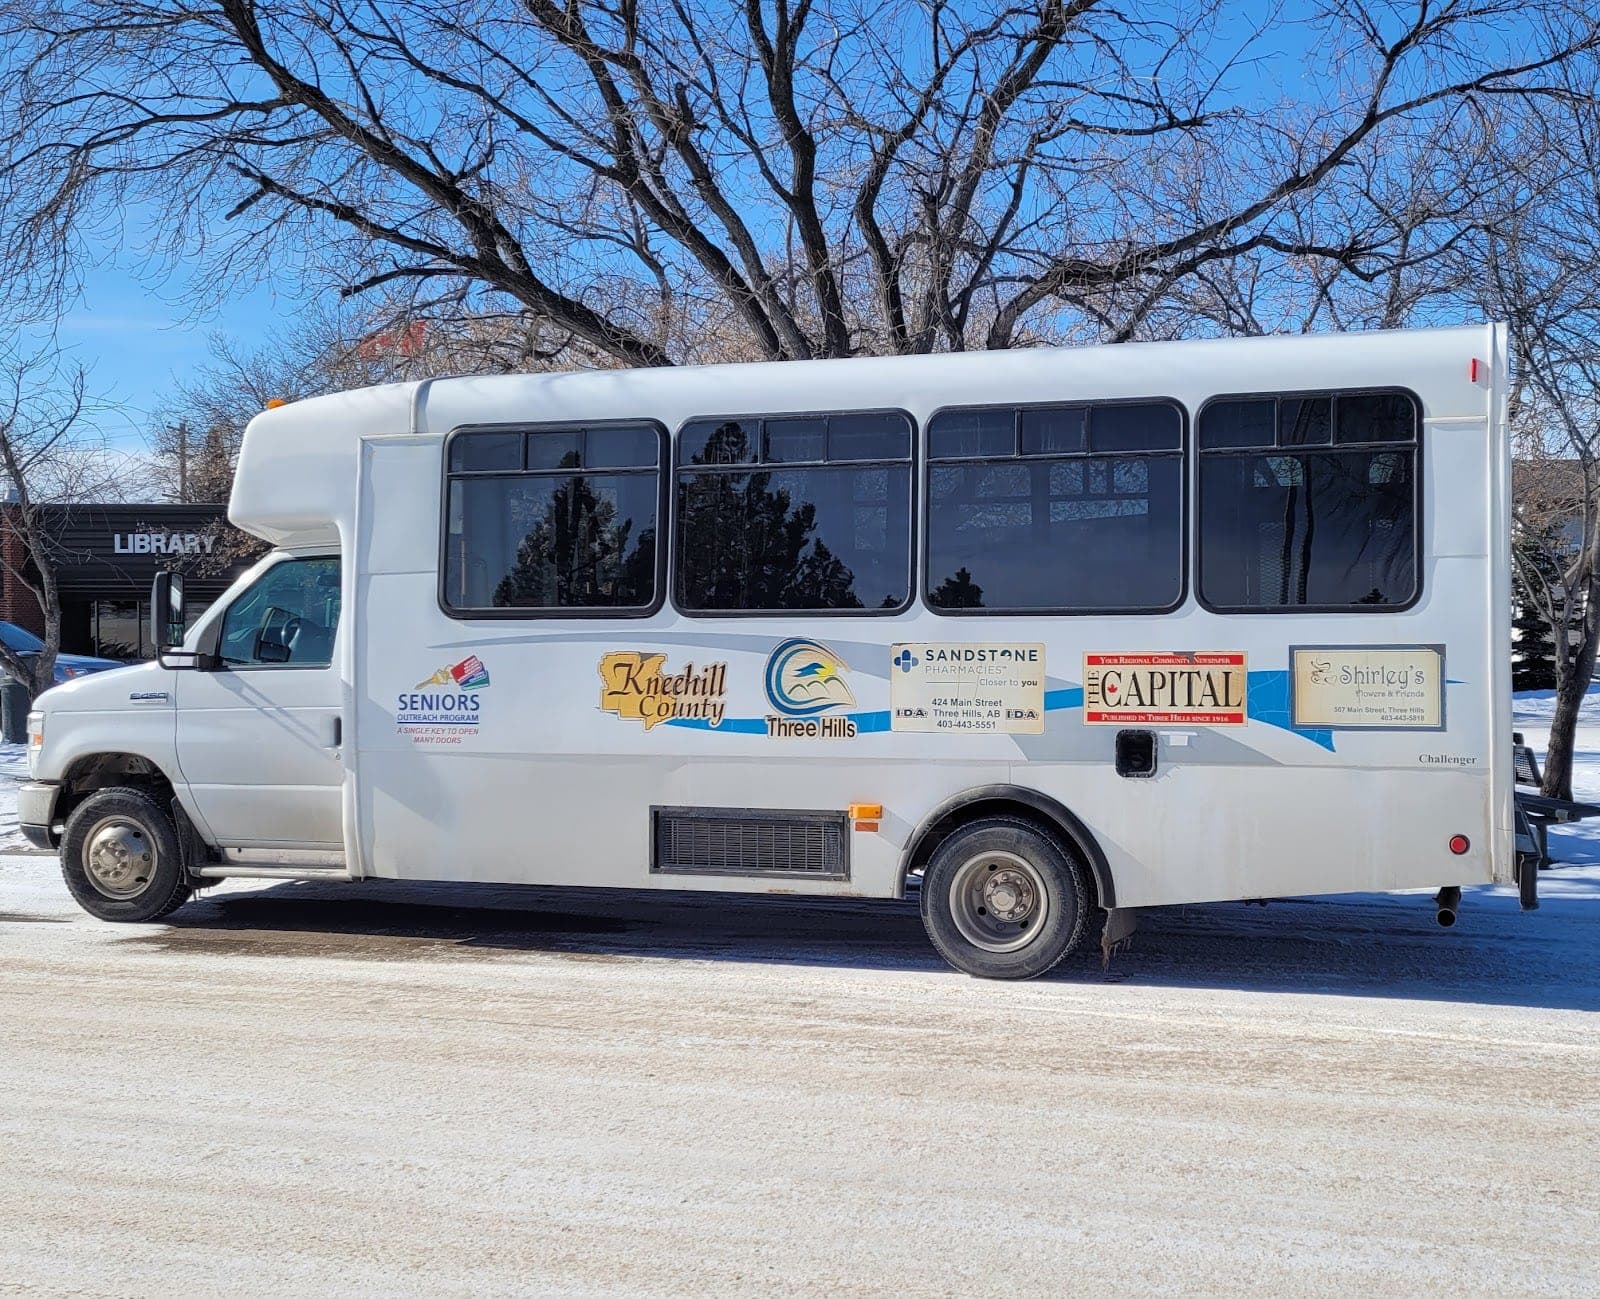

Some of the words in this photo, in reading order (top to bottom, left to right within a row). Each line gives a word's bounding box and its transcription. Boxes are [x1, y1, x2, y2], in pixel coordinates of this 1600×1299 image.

[114, 533, 215, 553] LIBRARY
[925, 649, 1038, 662] SANDSTONE
[607, 662, 726, 697] Kneehill
[979, 679, 1007, 687] Closer
[1009, 679, 1018, 687] to
[1021, 679, 1038, 688] you
[1340, 665, 1425, 689] Shirley's
[1087, 670, 1100, 708] THE
[1101, 670, 1243, 708] CAPITAL
[398, 694, 480, 711] SENIORS
[931, 698, 948, 707] 424
[950, 698, 972, 707] Main
[975, 698, 1003, 708] Street
[639, 695, 725, 726] County
[933, 708, 959, 718] Three
[987, 710, 1001, 718] AB
[397, 713, 438, 721] OUTREACH
[439, 714, 479, 722] PROGRAM
[403, 727, 430, 735] SINGLE
[767, 718, 817, 737] Three
[821, 718, 856, 738] Hills
[936, 720, 997, 729] 403-443-5551
[413, 736, 435, 744] MANY
[435, 736, 462, 744] DOORS
[1419, 754, 1477, 766] Challenger
